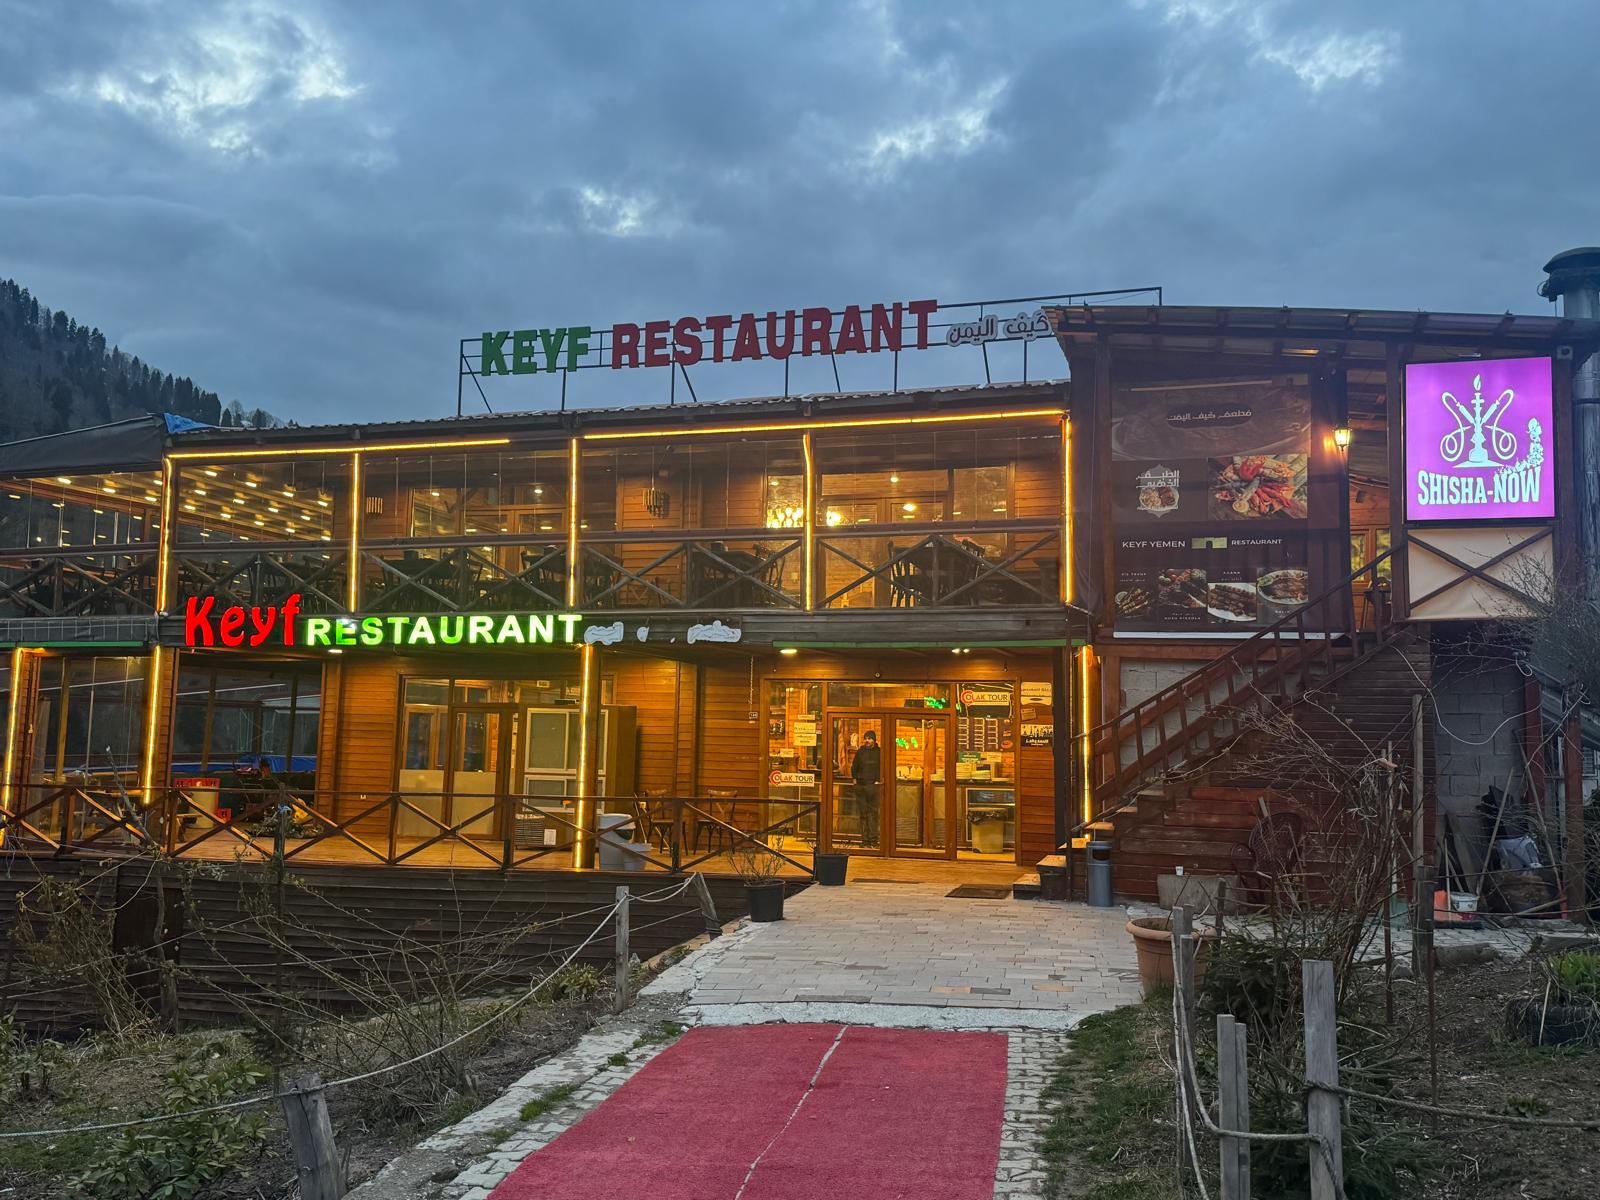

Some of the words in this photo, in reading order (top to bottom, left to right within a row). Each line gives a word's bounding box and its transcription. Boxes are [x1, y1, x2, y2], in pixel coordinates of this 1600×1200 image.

[481, 326, 591, 376] KEYF
[611, 300, 938, 369] RESTAURANT
[946, 314, 999, 347] اليمن
[1417, 466, 1541, 505] SHISHA-NOW
[1150, 540, 1186, 548] YEMEN
[185, 593, 302, 647] Keyf
[306, 614, 583, 646] RESTAURANT
